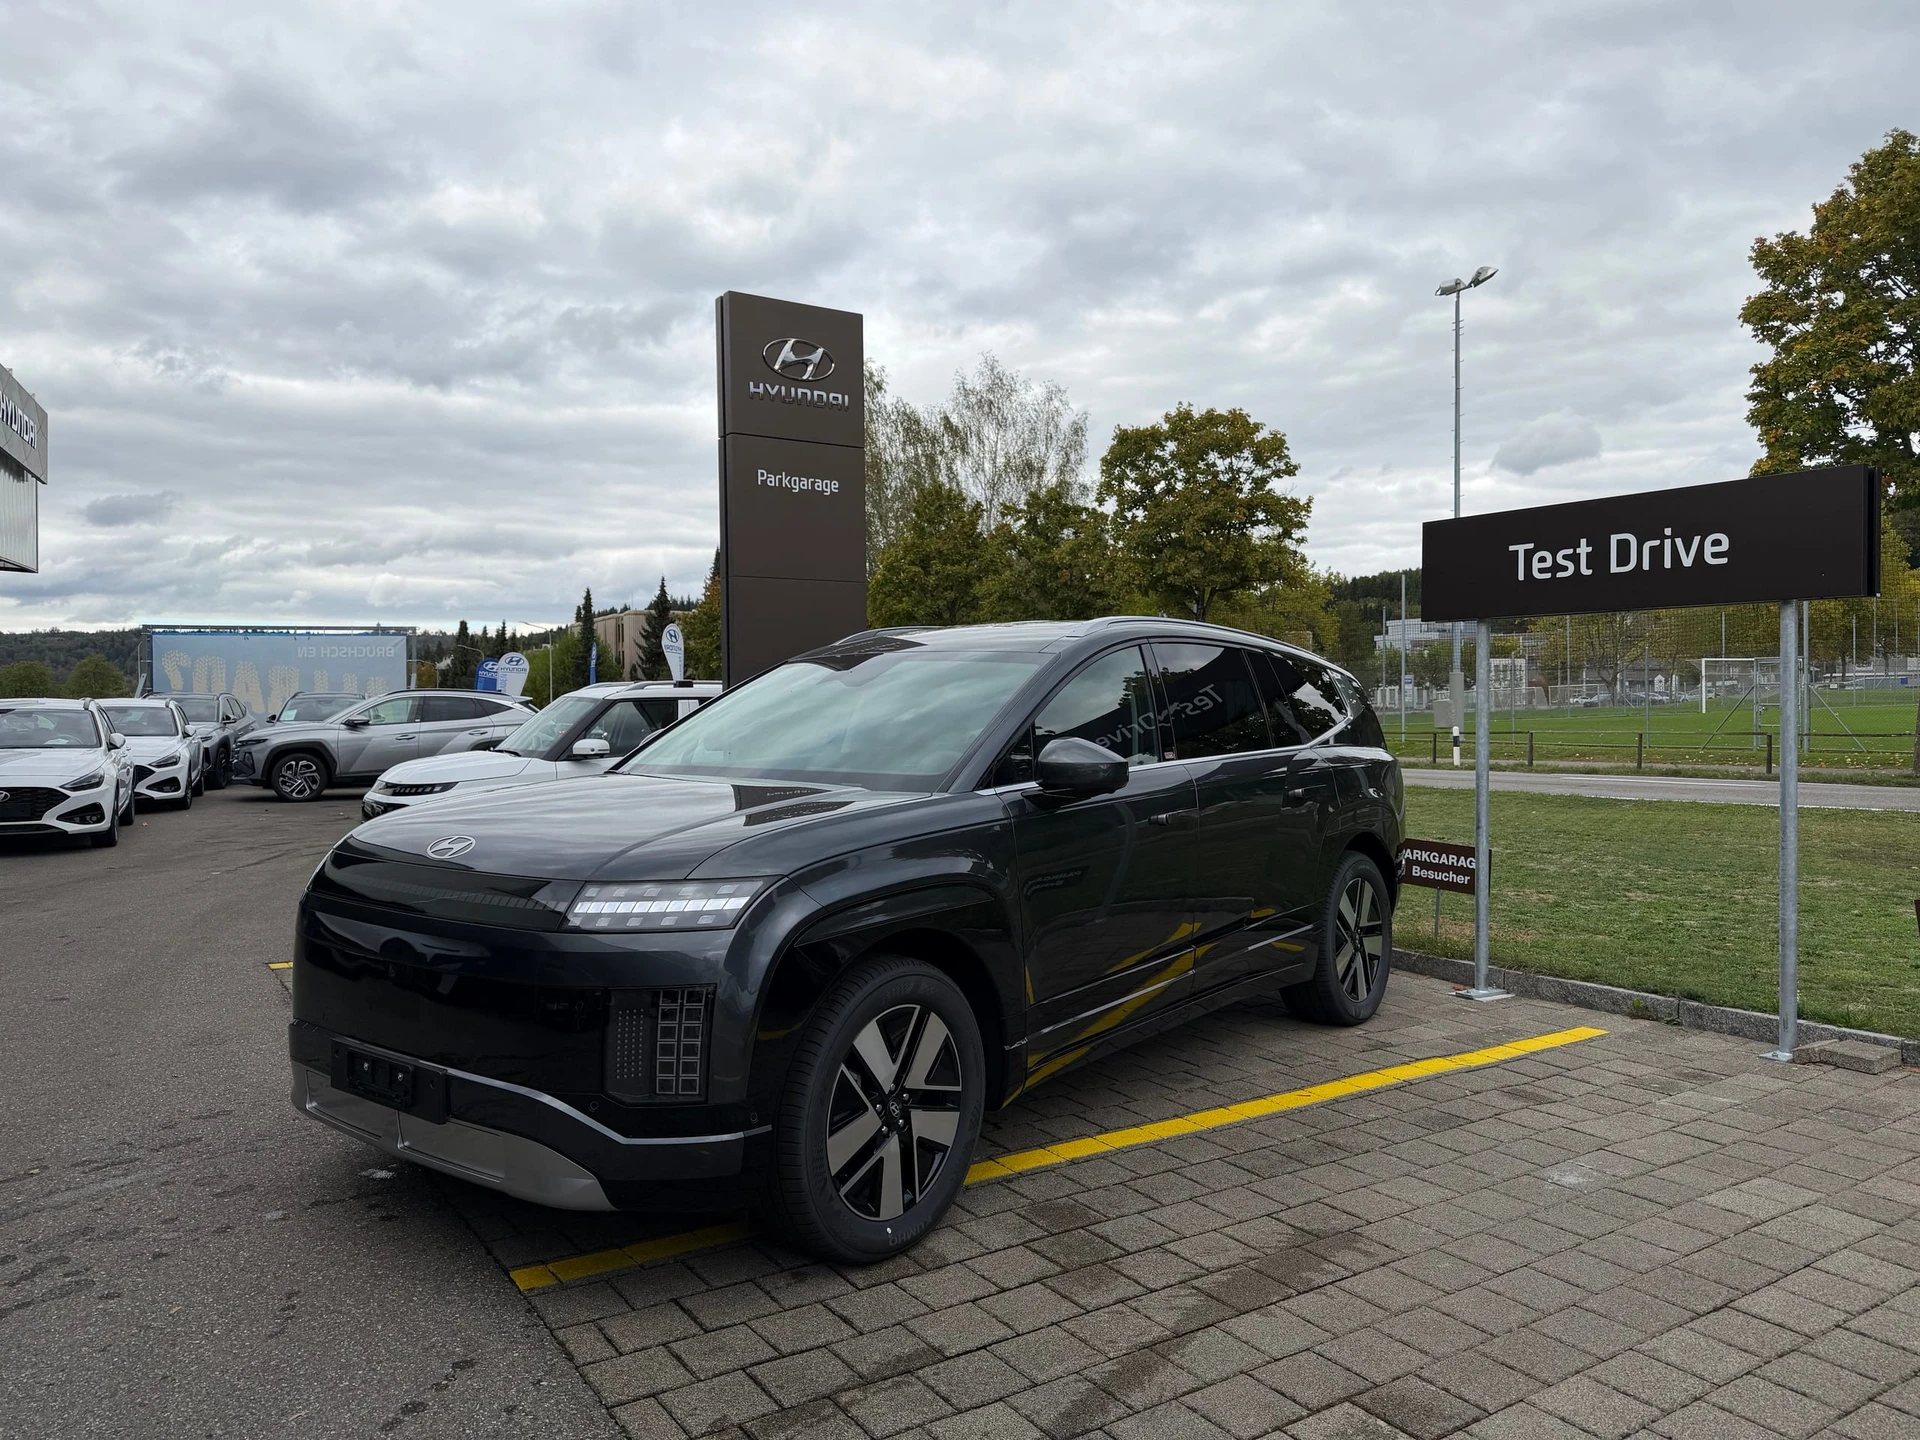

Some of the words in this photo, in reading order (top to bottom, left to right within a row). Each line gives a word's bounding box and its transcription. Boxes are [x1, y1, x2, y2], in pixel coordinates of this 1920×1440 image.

[749, 381, 849, 411] HYUNDAI
[0, 391, 38, 450] HYUNDAI
[757, 469, 839, 496] Parkgarage
[1508, 537, 1593, 581] Test
[1609, 527, 1731, 574] Drive
[1403, 848, 1476, 869] ARKGARAG
[1412, 865, 1471, 885] Besucher
